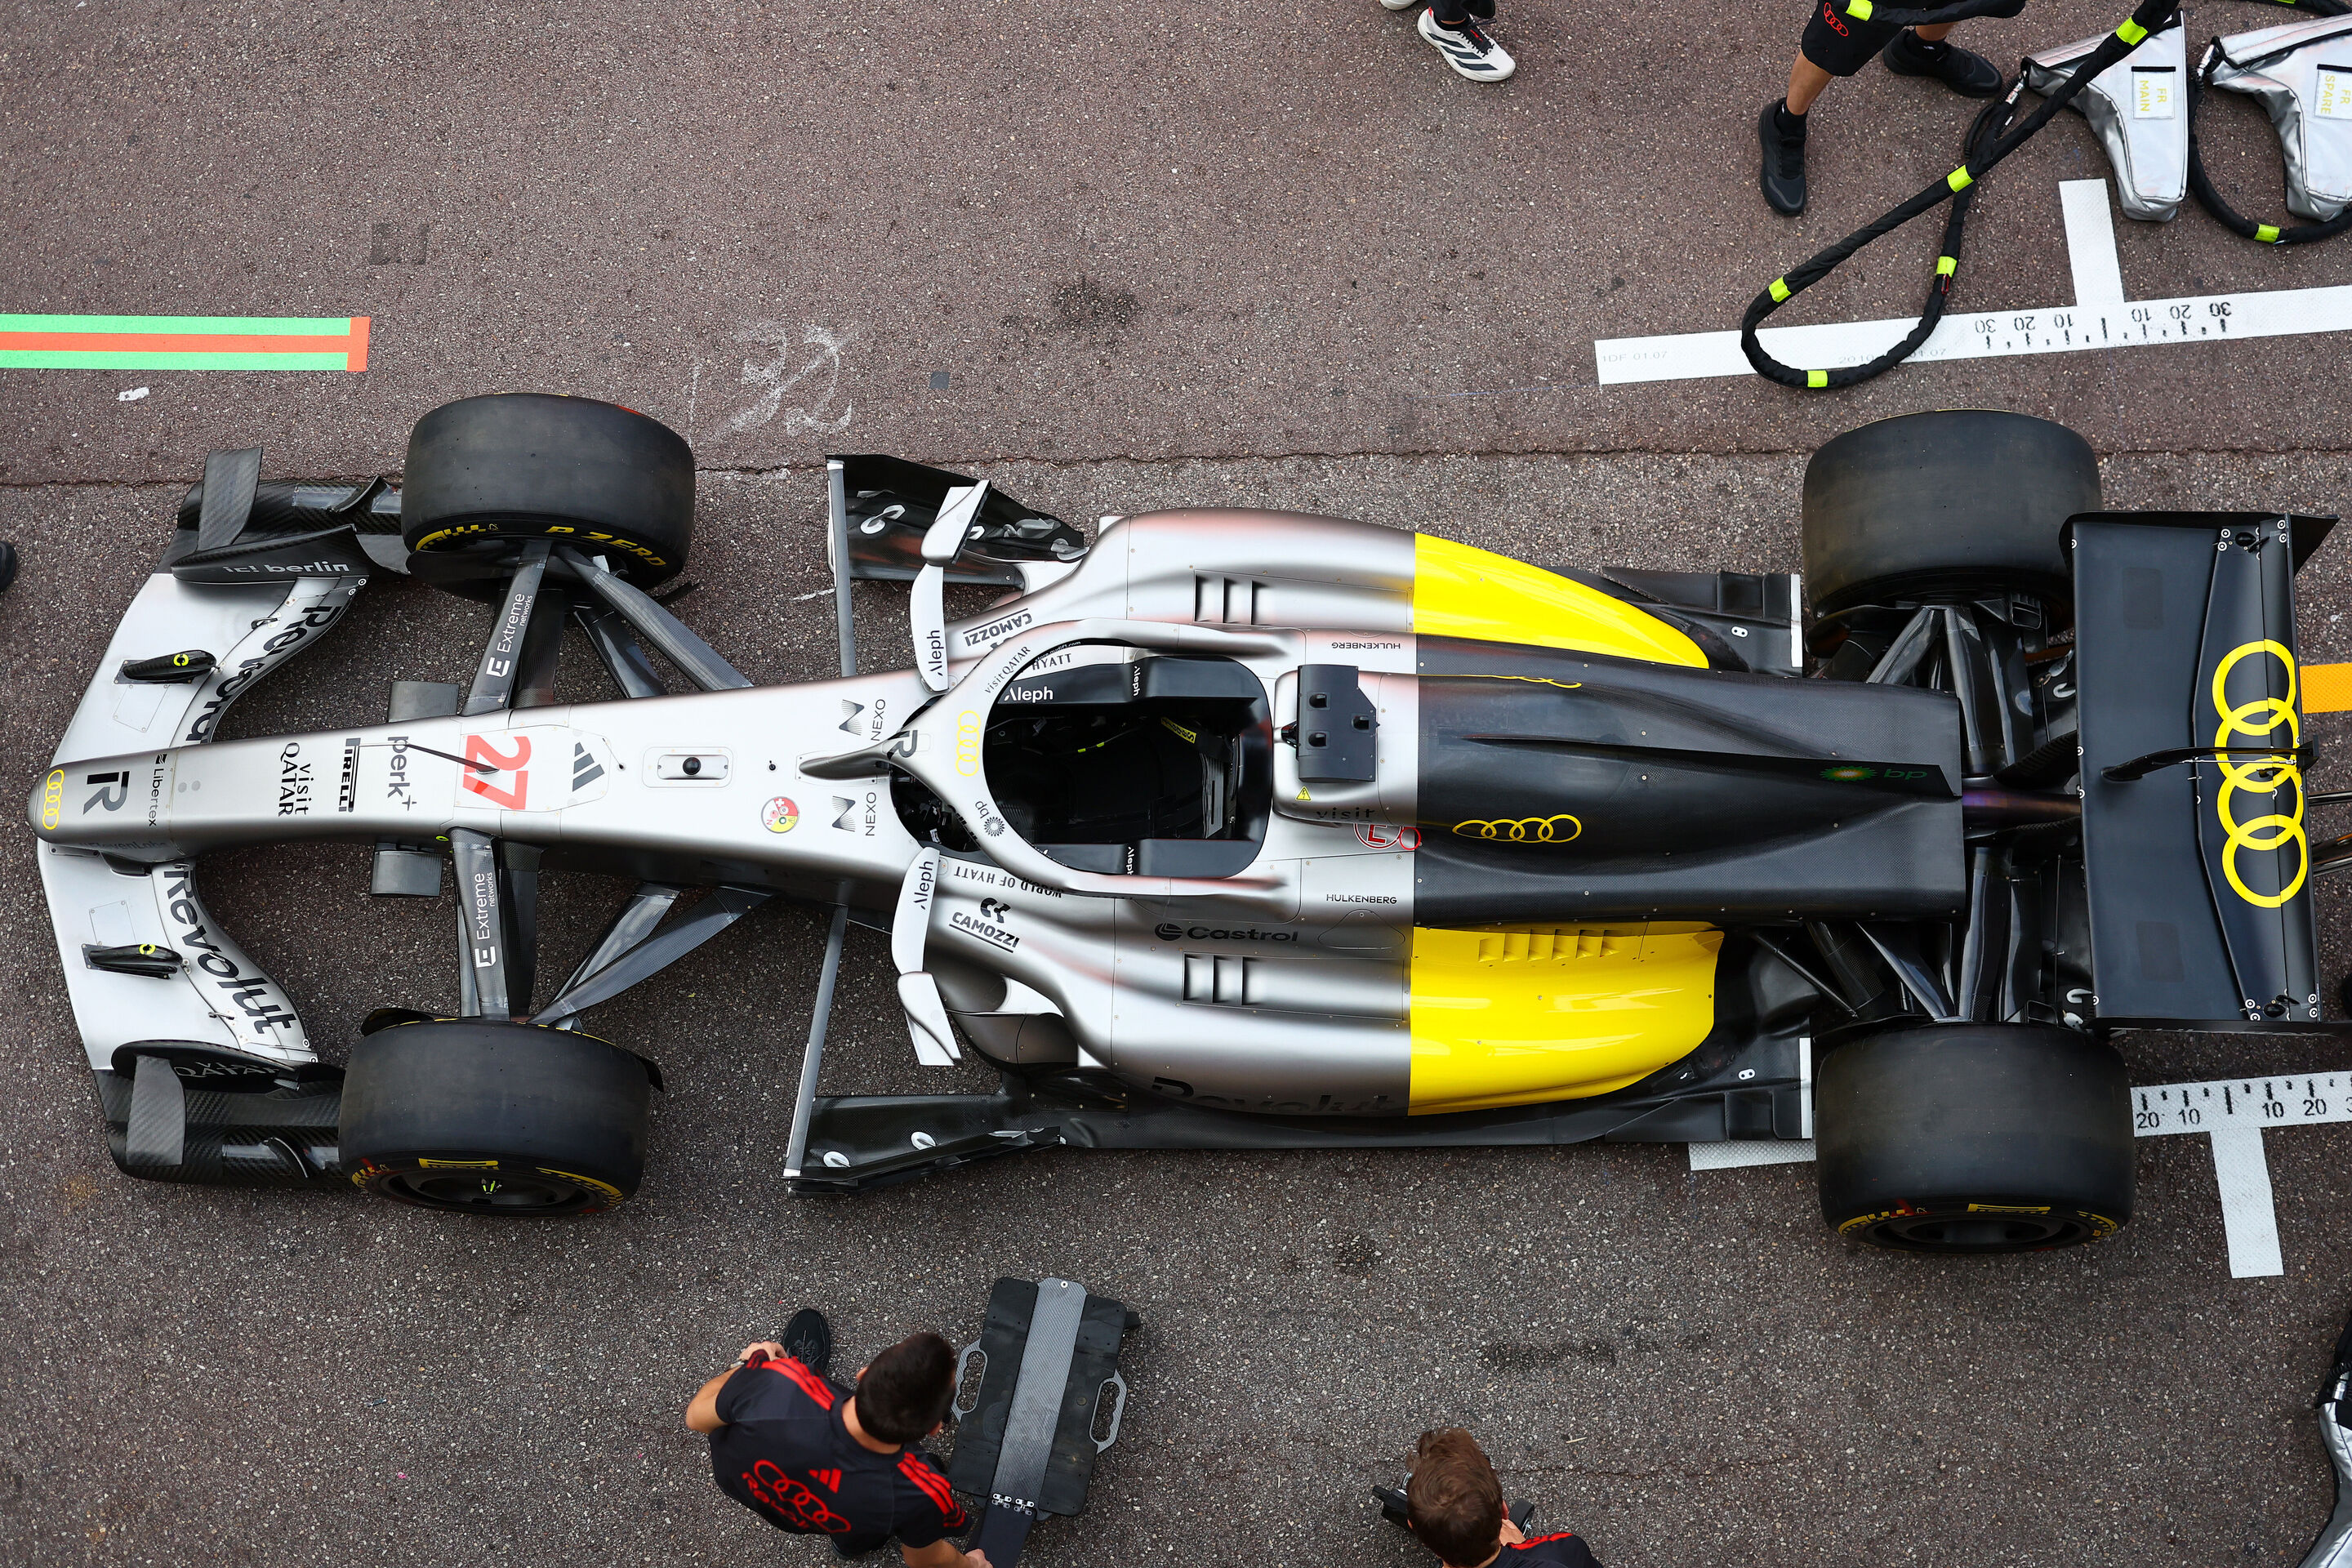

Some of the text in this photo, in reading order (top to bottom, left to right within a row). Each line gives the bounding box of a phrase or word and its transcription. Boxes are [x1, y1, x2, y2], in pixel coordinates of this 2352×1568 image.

[2139, 80, 2150, 112] MAIN
[2157, 88, 2167, 103] FR
[2320, 74, 2336, 114] SPARE
[2339, 89, 2351, 105] FR
[1974, 301, 2232, 334] 30 20 10 10 20 30
[497, 593, 525, 654] Extreme
[519, 595, 533, 627] networks
[964, 612, 1032, 647] CAMOZZI
[1330, 642, 1401, 650] HULKENBERG
[927, 630, 943, 676] Aleph
[1031, 653, 1072, 670] HYATT
[1004, 685, 1054, 703] Aleph
[1133, 665, 1141, 697] Aleph
[871, 699, 886, 742] NEXO
[278, 742, 301, 817] QATAR
[294, 762, 312, 815] visit
[338, 737, 361, 813] PIRELLI
[462, 735, 532, 810] 27
[1884, 768, 1927, 782] bp
[148, 768, 165, 827] Libertex
[865, 791, 877, 836] NEXO
[975, 800, 990, 819] bp
[1316, 807, 1376, 819] visit
[486, 871, 496, 907] networks
[914, 861, 934, 911] Aleph
[954, 866, 995, 884] HYATT
[999, 876, 1015, 889] OF
[474, 873, 490, 940] Extreme
[1326, 893, 1397, 904] HULKENBERG
[951, 911, 1020, 948] CAMOZZI
[1187, 925, 1298, 942] Castrol
[163, 869, 297, 1035] Revolut
[2136, 1111, 2160, 1129] 20
[2178, 1108, 2201, 1126] 10
[2261, 1101, 2284, 1119] 10
[2303, 1098, 2328, 1116] 20
